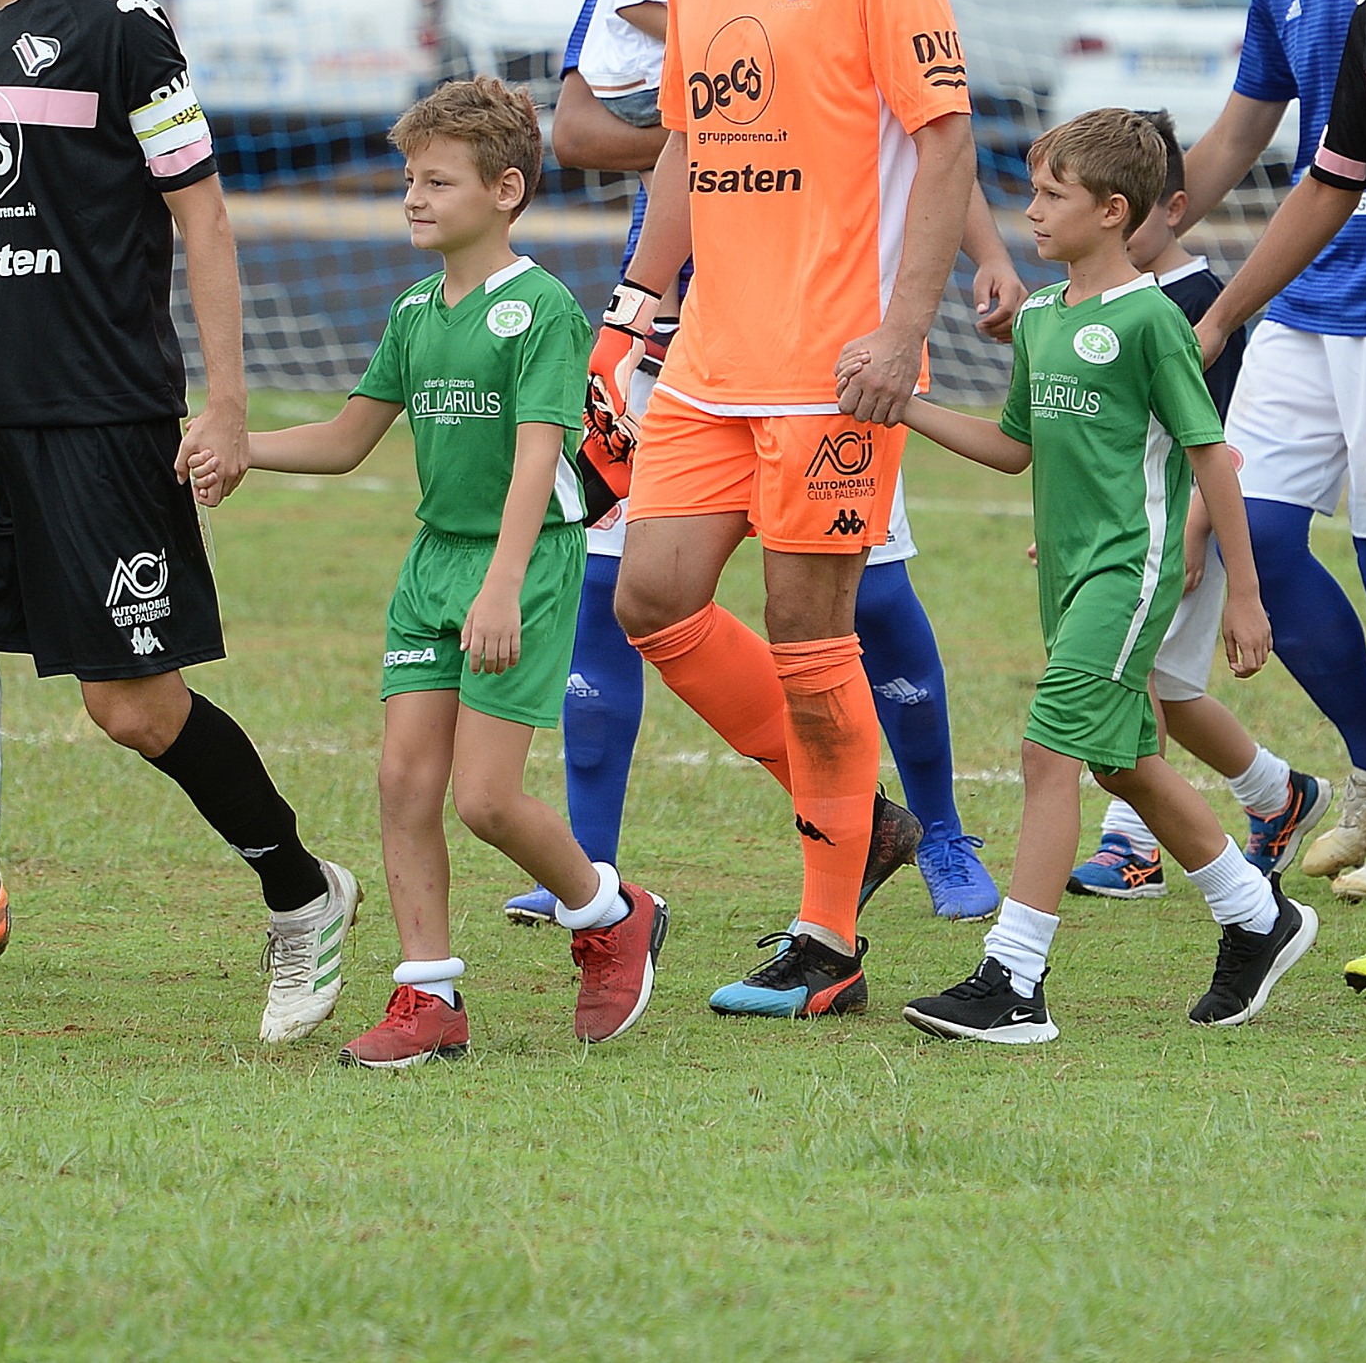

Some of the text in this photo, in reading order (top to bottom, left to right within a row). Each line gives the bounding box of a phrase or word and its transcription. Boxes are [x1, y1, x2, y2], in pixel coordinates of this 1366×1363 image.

[698, 129, 788, 145] gruppoarena.it
[689, 161, 803, 193] isaten
[412, 390, 502, 414] CELLARIUS
[807, 478, 876, 491] AUTOMOBILE
[807, 487, 876, 501] CLUB PALERMO
[112, 596, 171, 619] AUTOMOBILE
[135, 606, 171, 625] PALERMO
